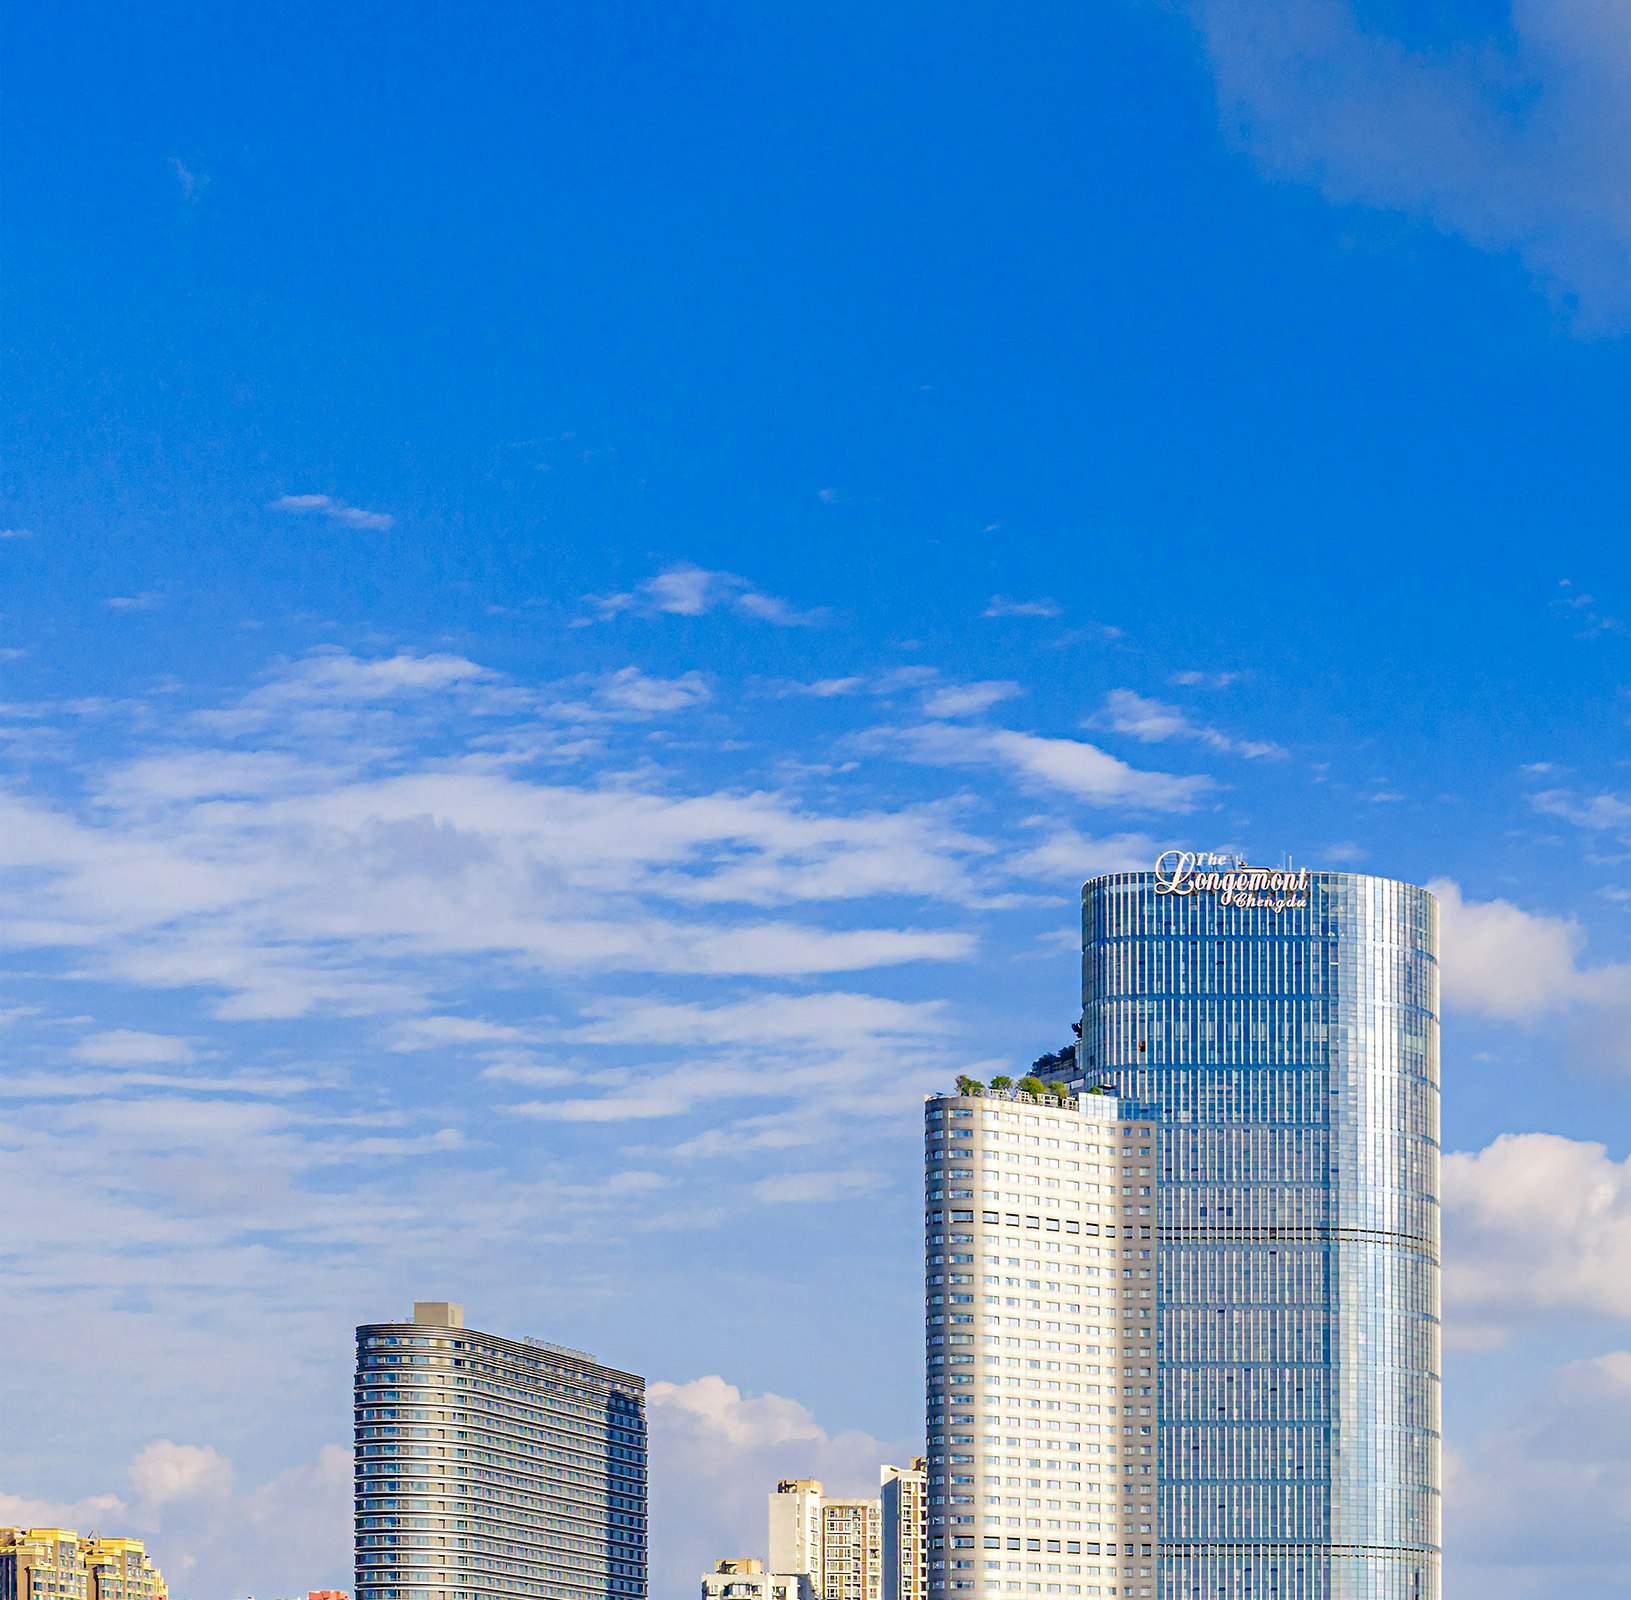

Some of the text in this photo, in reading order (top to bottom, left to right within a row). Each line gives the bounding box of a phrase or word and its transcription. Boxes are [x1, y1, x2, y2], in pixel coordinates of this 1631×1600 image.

[1194, 851, 1228, 867] The
[1153, 849, 1310, 907] Longemont
[1233, 892, 1308, 914] Chengdu
